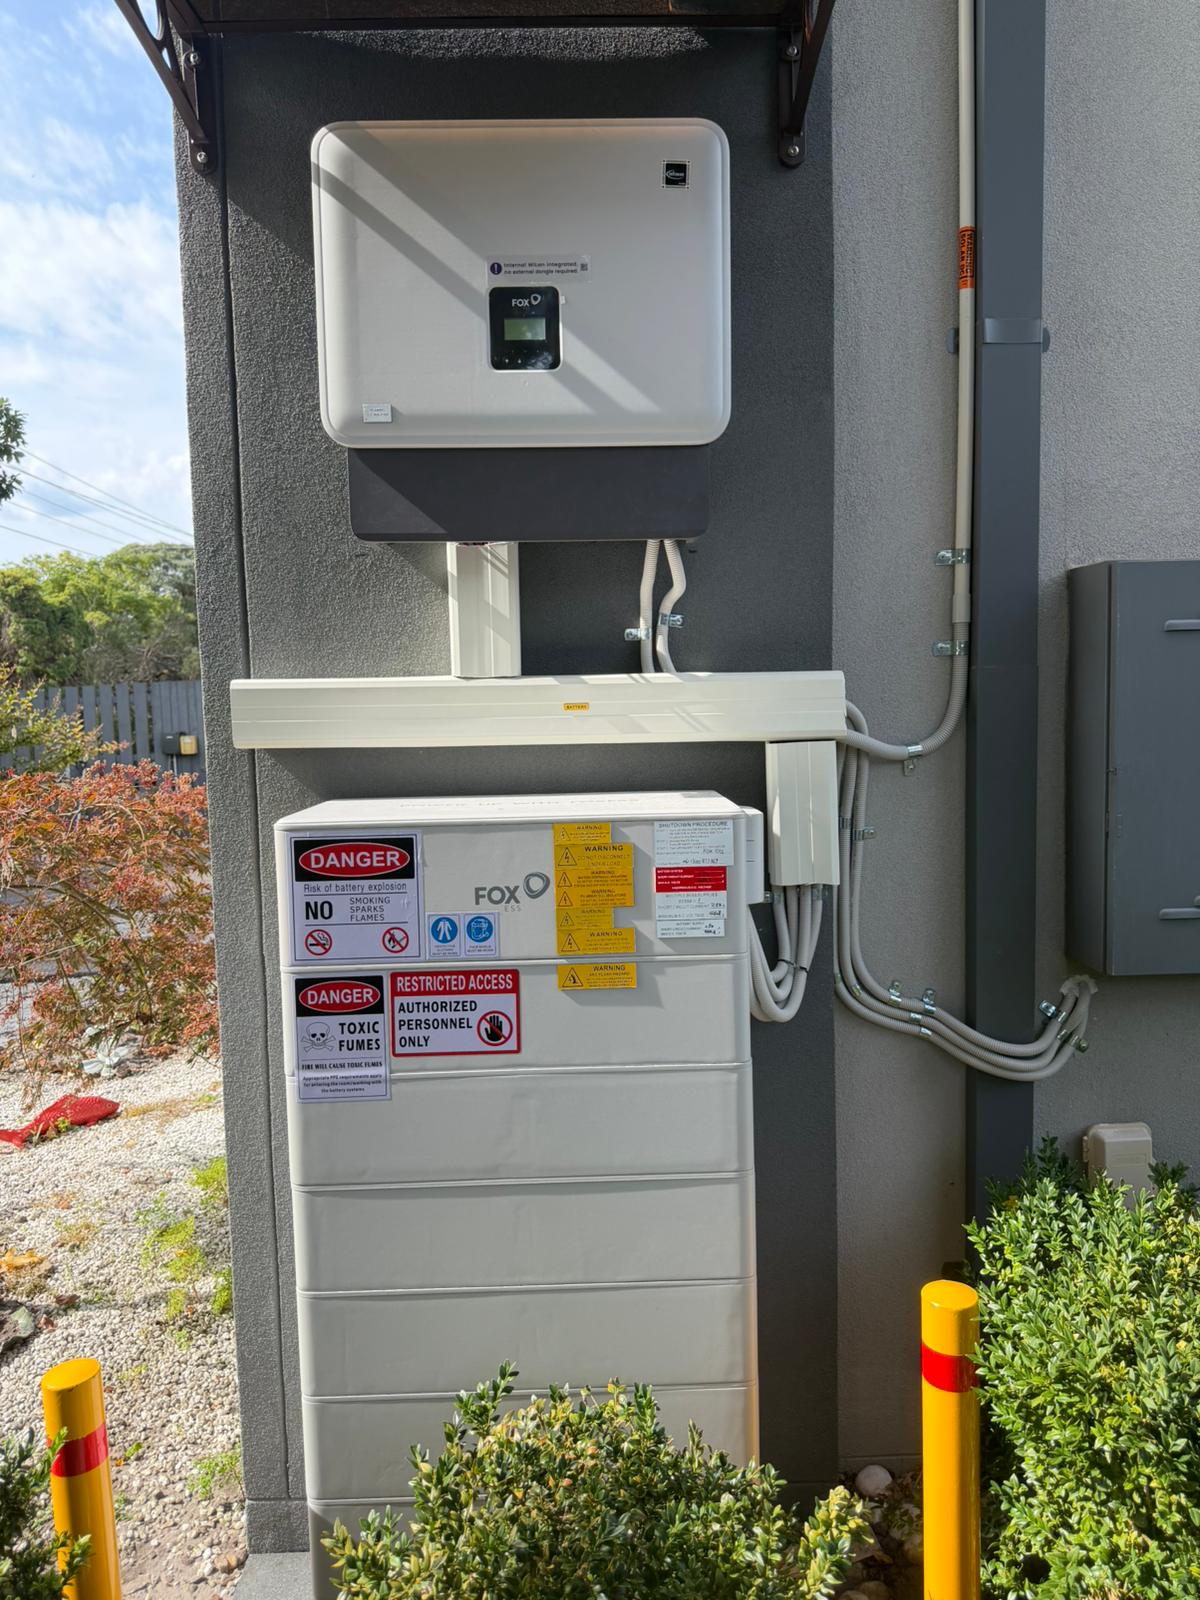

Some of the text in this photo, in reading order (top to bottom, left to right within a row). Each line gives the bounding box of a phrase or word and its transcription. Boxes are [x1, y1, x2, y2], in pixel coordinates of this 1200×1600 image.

[511, 298, 530, 307] FOX
[692, 820, 728, 828] PROCEDURE
[584, 844, 624, 852] WARNING
[310, 851, 400, 868] DANGER
[303, 882, 407, 894] Risk of battery explosion
[349, 896, 391, 905] SMOKING
[474, 885, 520, 905] FOX
[305, 900, 333, 920] NO
[350, 905, 385, 914] SPARKS
[350, 913, 385, 922] FLAMES
[593, 964, 626, 972] WARNING
[396, 974, 513, 992] RESTRICTED ACCESS
[307, 988, 374, 1005] DANGER
[398, 1000, 478, 1014] AUTHORIZED
[339, 1021, 380, 1035] TOXIC
[398, 1018, 473, 1030] PERSONNEL
[339, 1038, 380, 1051] FUMES
[399, 1035, 430, 1048] ONLY
[315, 1062, 328, 1070] WILL
[347, 1061, 363, 1069] TOXIC
[311, 1081, 330, 1089] entering
